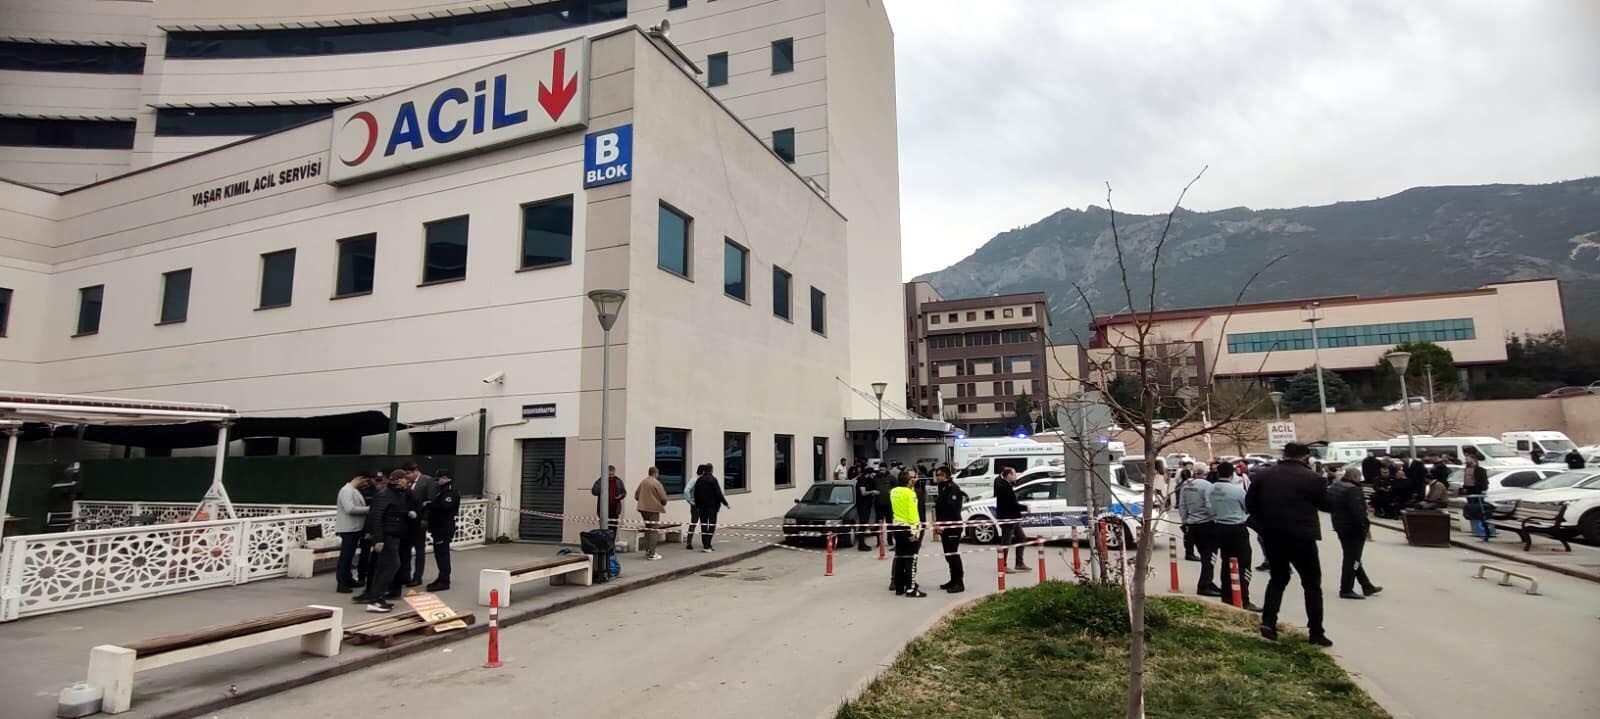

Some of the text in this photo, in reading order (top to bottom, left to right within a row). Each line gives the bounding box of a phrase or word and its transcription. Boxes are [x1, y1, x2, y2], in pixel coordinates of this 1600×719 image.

[595, 132, 620, 166] B
[192, 157, 322, 208] YAŞAR KIMIL ACİL SERVİSİ
[586, 163, 628, 183] BLOK
